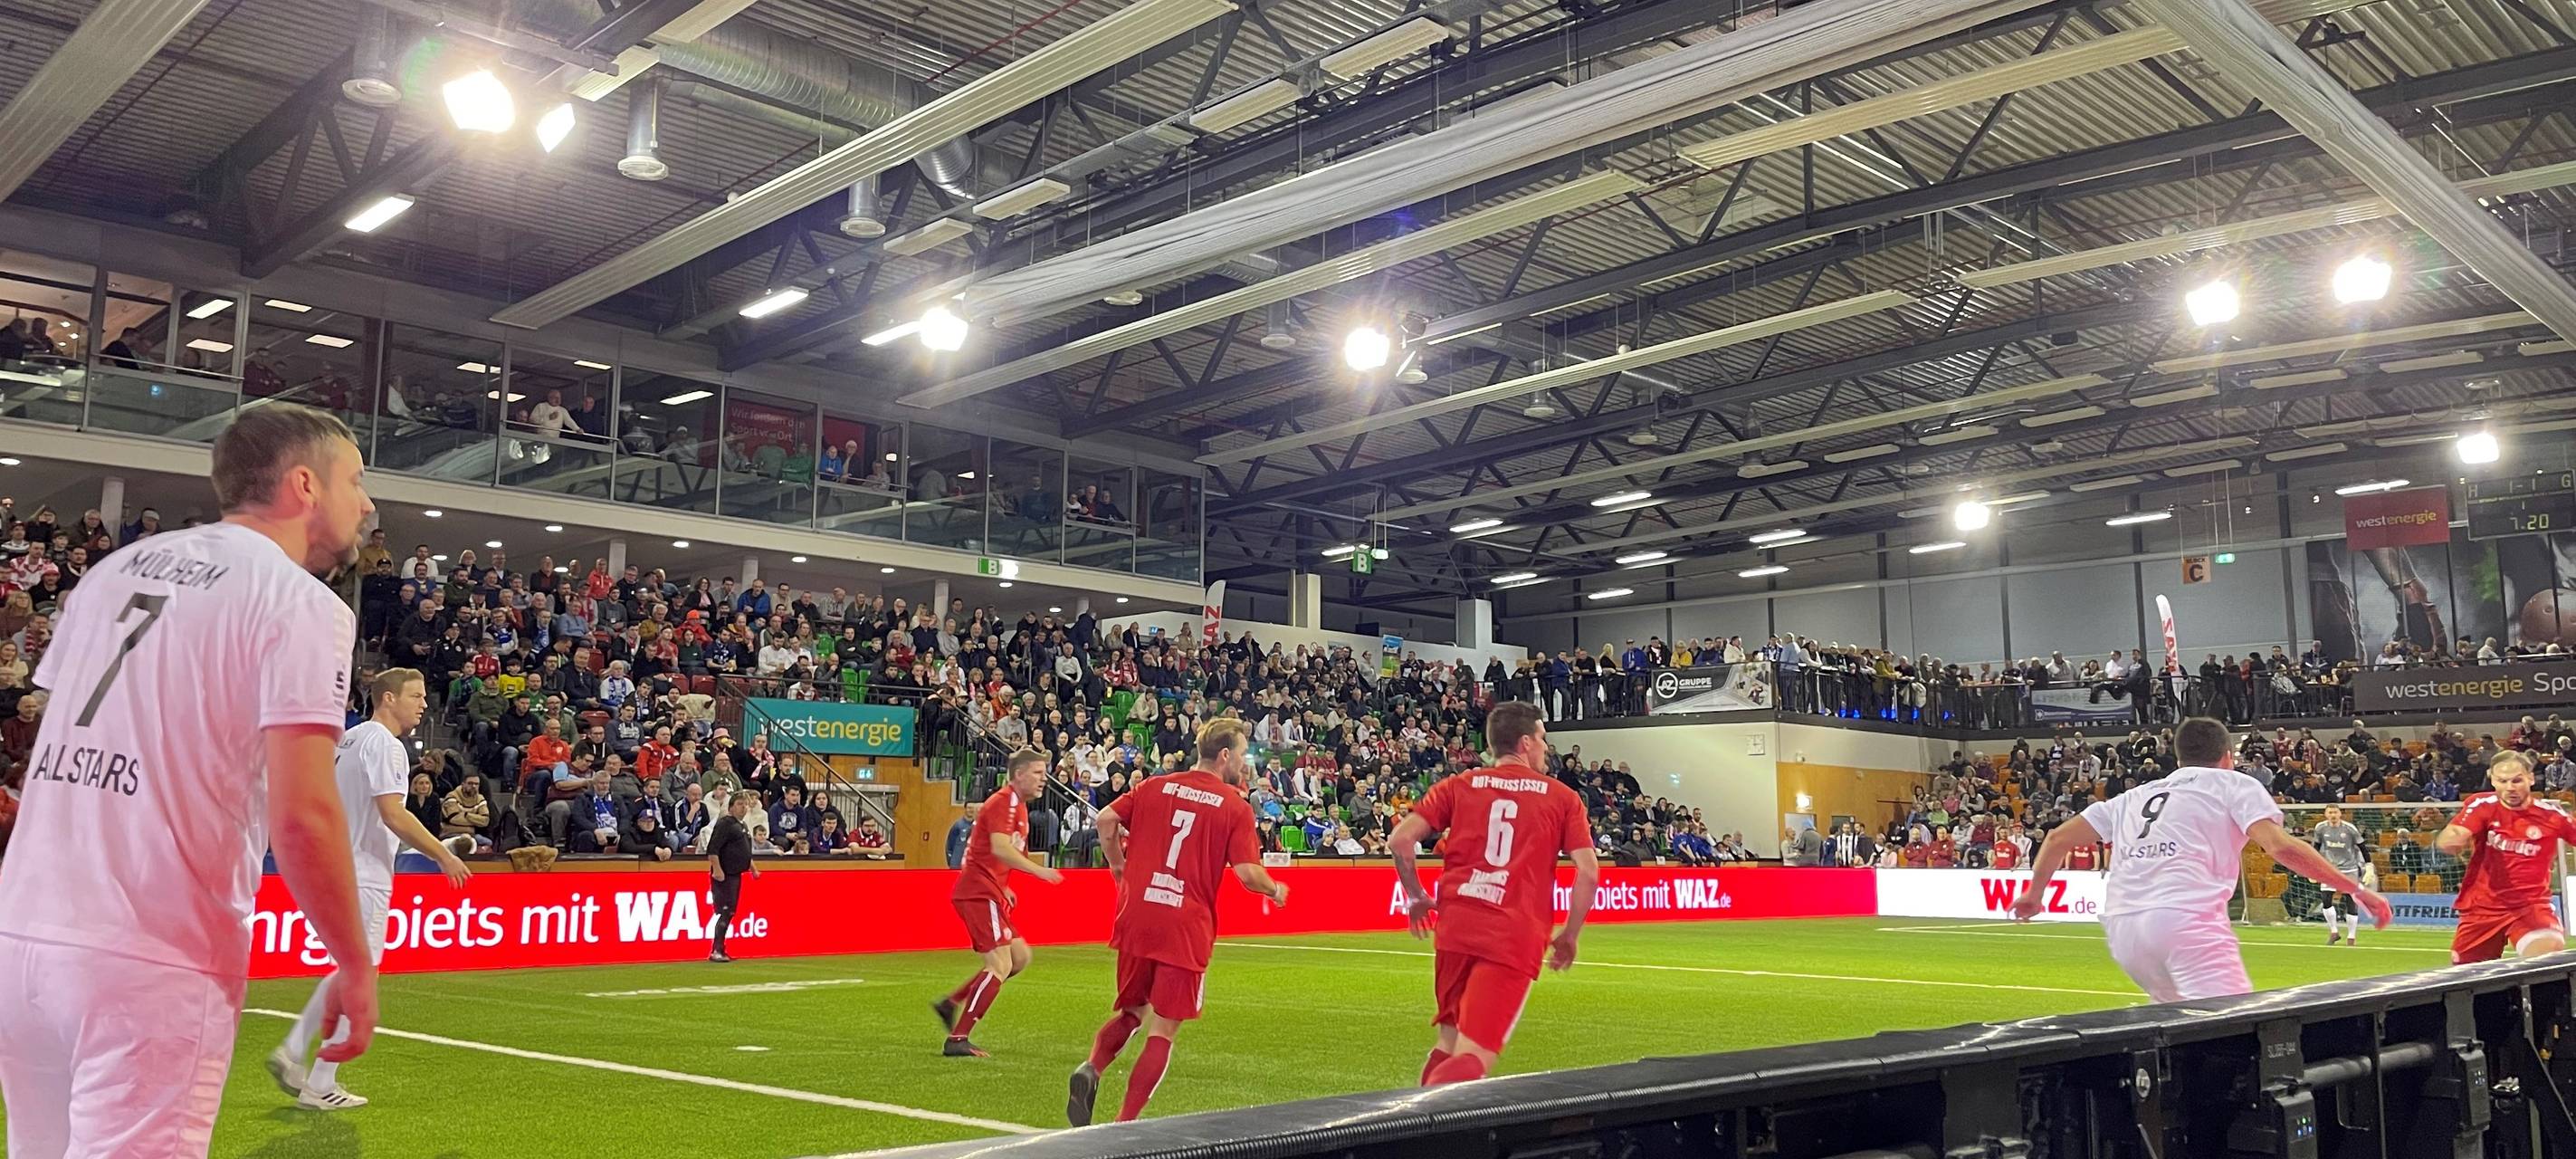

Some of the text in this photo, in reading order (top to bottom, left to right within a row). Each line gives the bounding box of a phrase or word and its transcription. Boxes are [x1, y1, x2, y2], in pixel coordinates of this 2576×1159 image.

[779, 431, 796, 444] Ort
[2356, 509, 2437, 528] westenergie
[119, 549, 230, 590] MÜLHEIM
[1357, 553, 1368, 571] B
[2189, 563, 2204, 582] C
[74, 591, 170, 728] 7
[1679, 676, 1712, 686] GRUPPE
[2385, 675, 2524, 699] westenergie
[758, 714, 902, 747] westenergie
[2137, 791, 2171, 839] 9
[1166, 809, 1197, 870] 7
[1484, 799, 1519, 867] 6
[1642, 879, 1671, 910] mit
[1674, 878, 1732, 909] WAZ.de
[1980, 878, 2097, 915] WZ.de
[520, 893, 600, 944] mit
